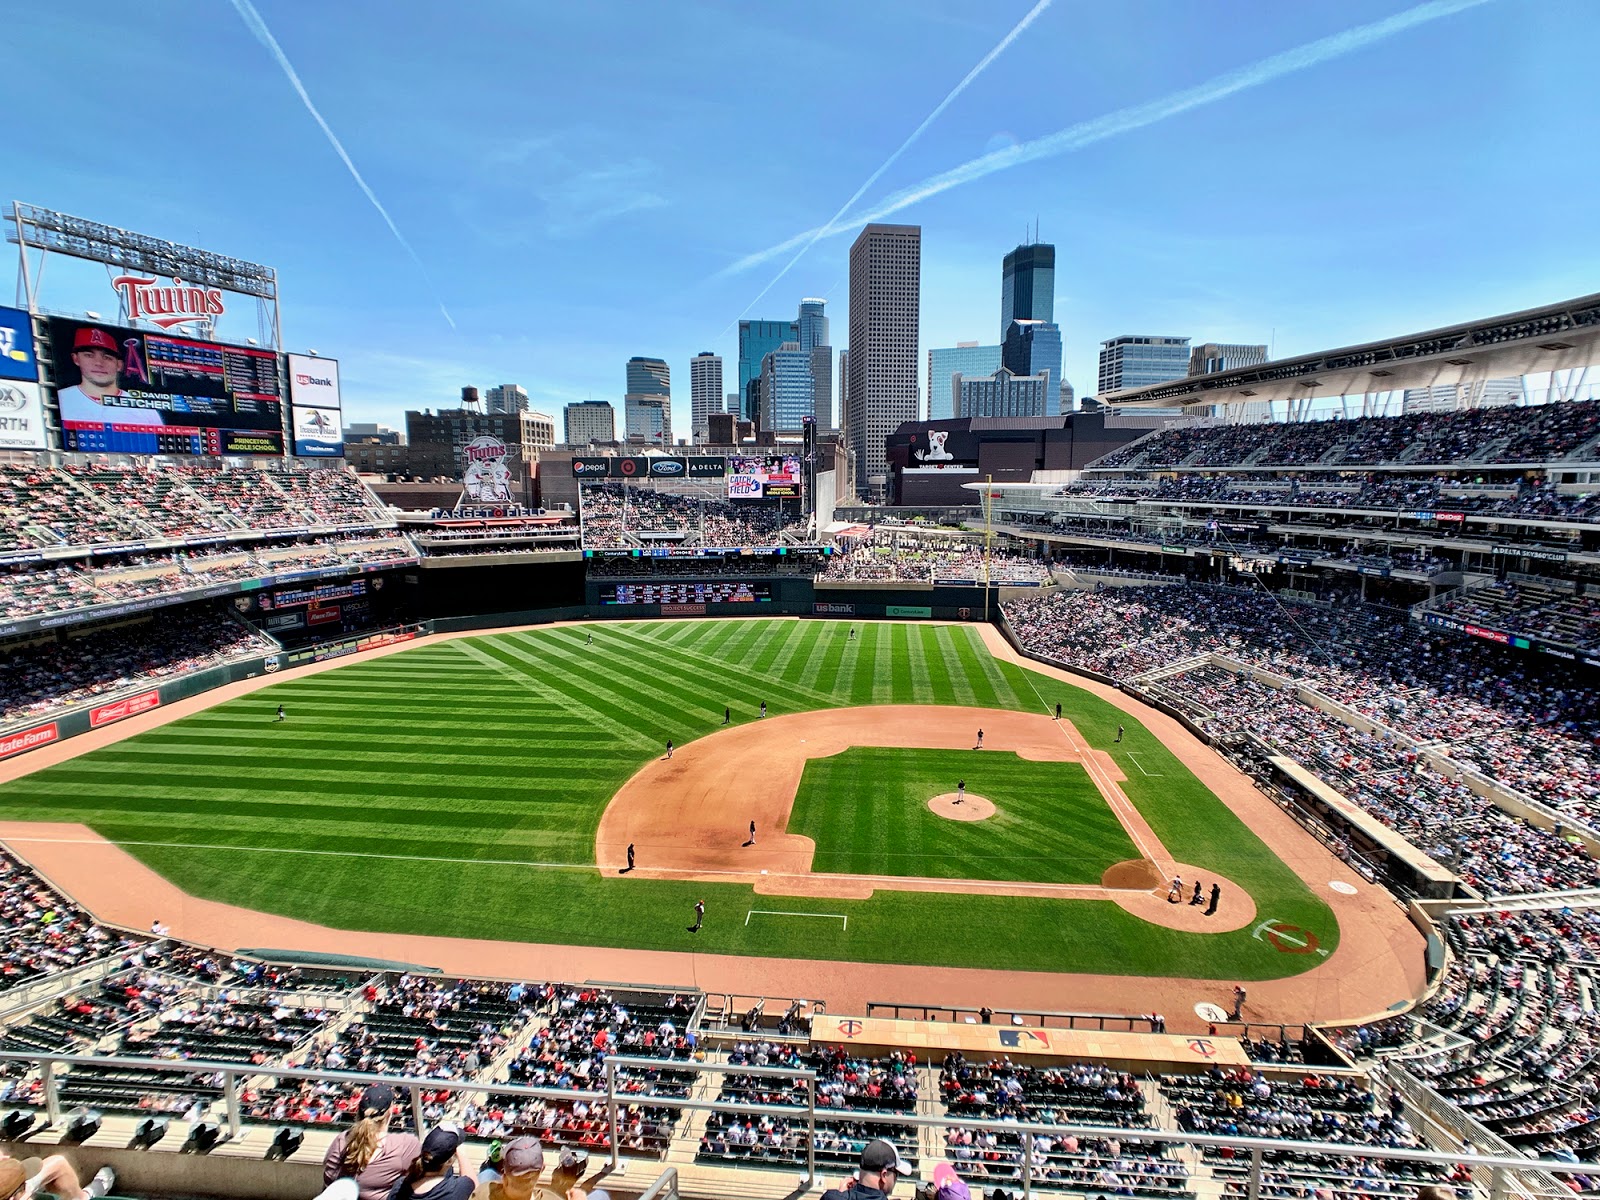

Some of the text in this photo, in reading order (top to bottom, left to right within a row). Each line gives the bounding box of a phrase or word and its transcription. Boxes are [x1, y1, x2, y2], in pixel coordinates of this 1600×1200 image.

[112, 274, 224, 320] Twins
[141, 392, 170, 400] DAVID
[104, 396, 171, 410] FLETCHER
[464, 444, 506, 463] Twins
[585, 463, 605, 472] pepsi
[658, 463, 676, 471] Ford
[730, 486, 749, 494] FIELD
[433, 508, 546, 519] TARGET FIELD
[40, 613, 84, 627] CenturyLink
[89, 607, 125, 619] Technology
[126, 602, 147, 611] Partner
[1546, 648, 1575, 660] CenturyLink
